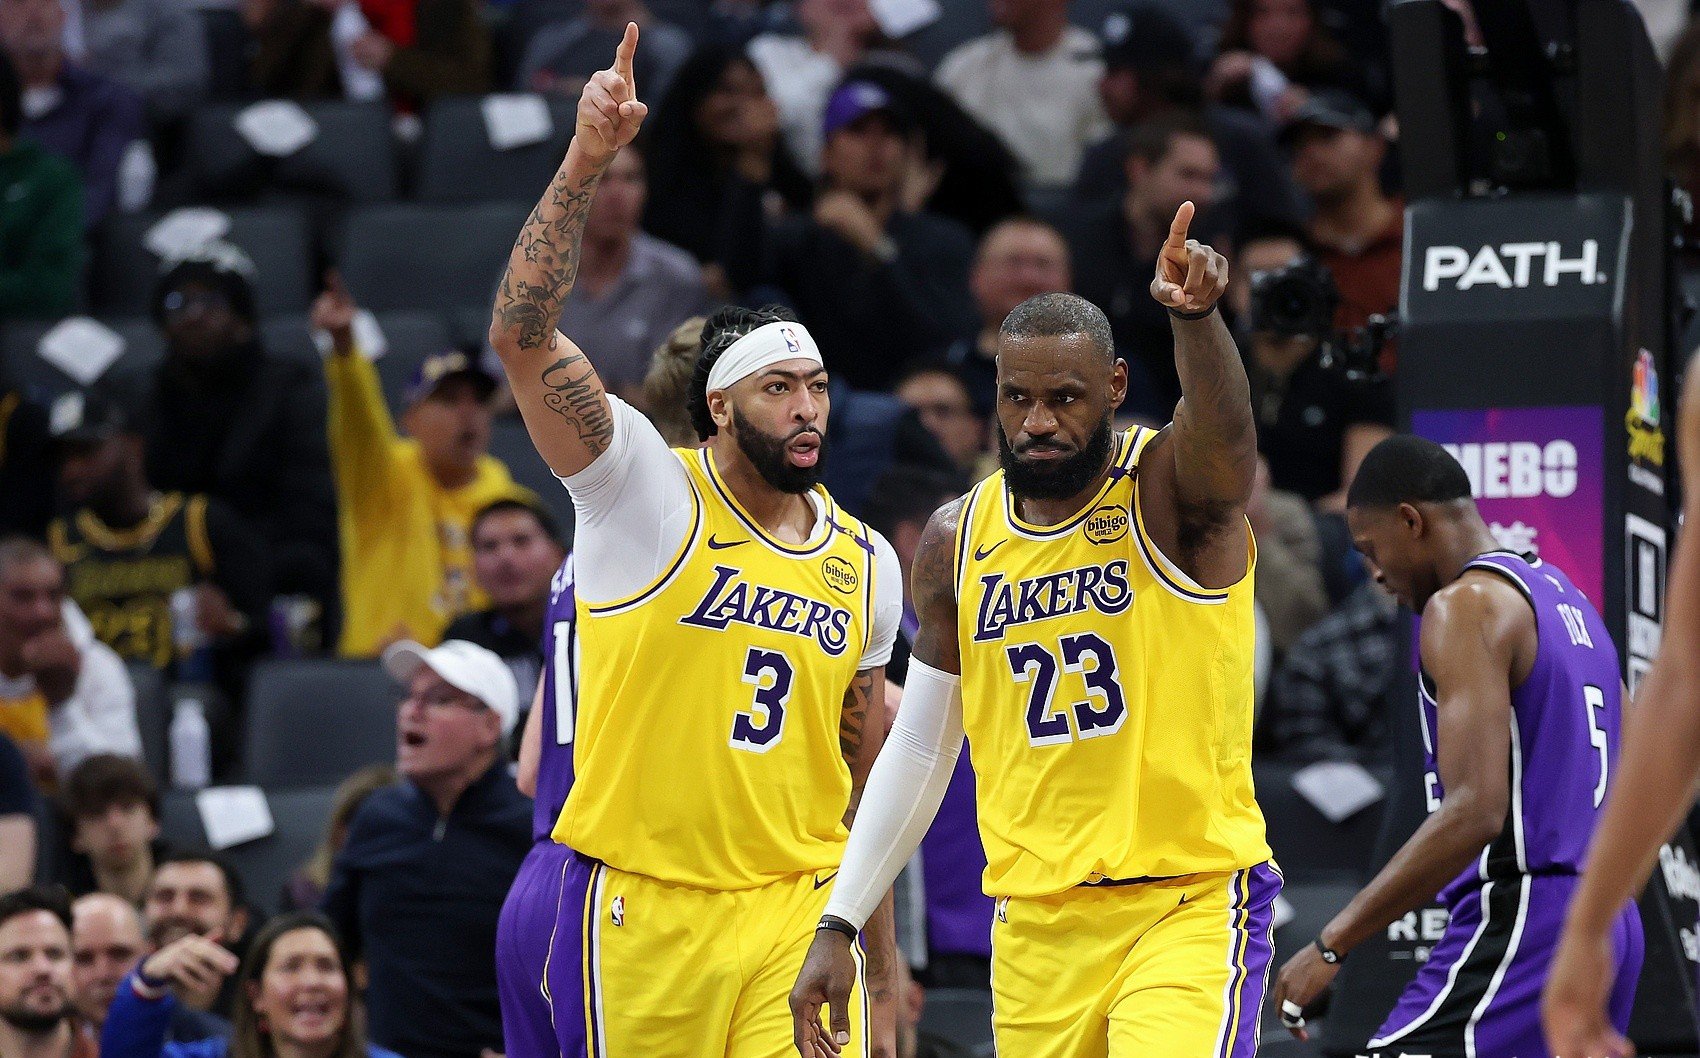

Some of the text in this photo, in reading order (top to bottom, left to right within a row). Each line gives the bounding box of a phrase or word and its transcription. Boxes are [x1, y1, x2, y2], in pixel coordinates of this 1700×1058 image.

[825, 562, 856, 586] bibigo
[1087, 514, 1128, 532] bibigo
[677, 563, 853, 658] LAKERS
[973, 559, 1135, 644] LAKERS
[553, 620, 581, 737] 1
[728, 644, 797, 755] 3
[1004, 630, 1130, 749] 23
[1583, 685, 1609, 811] 5
